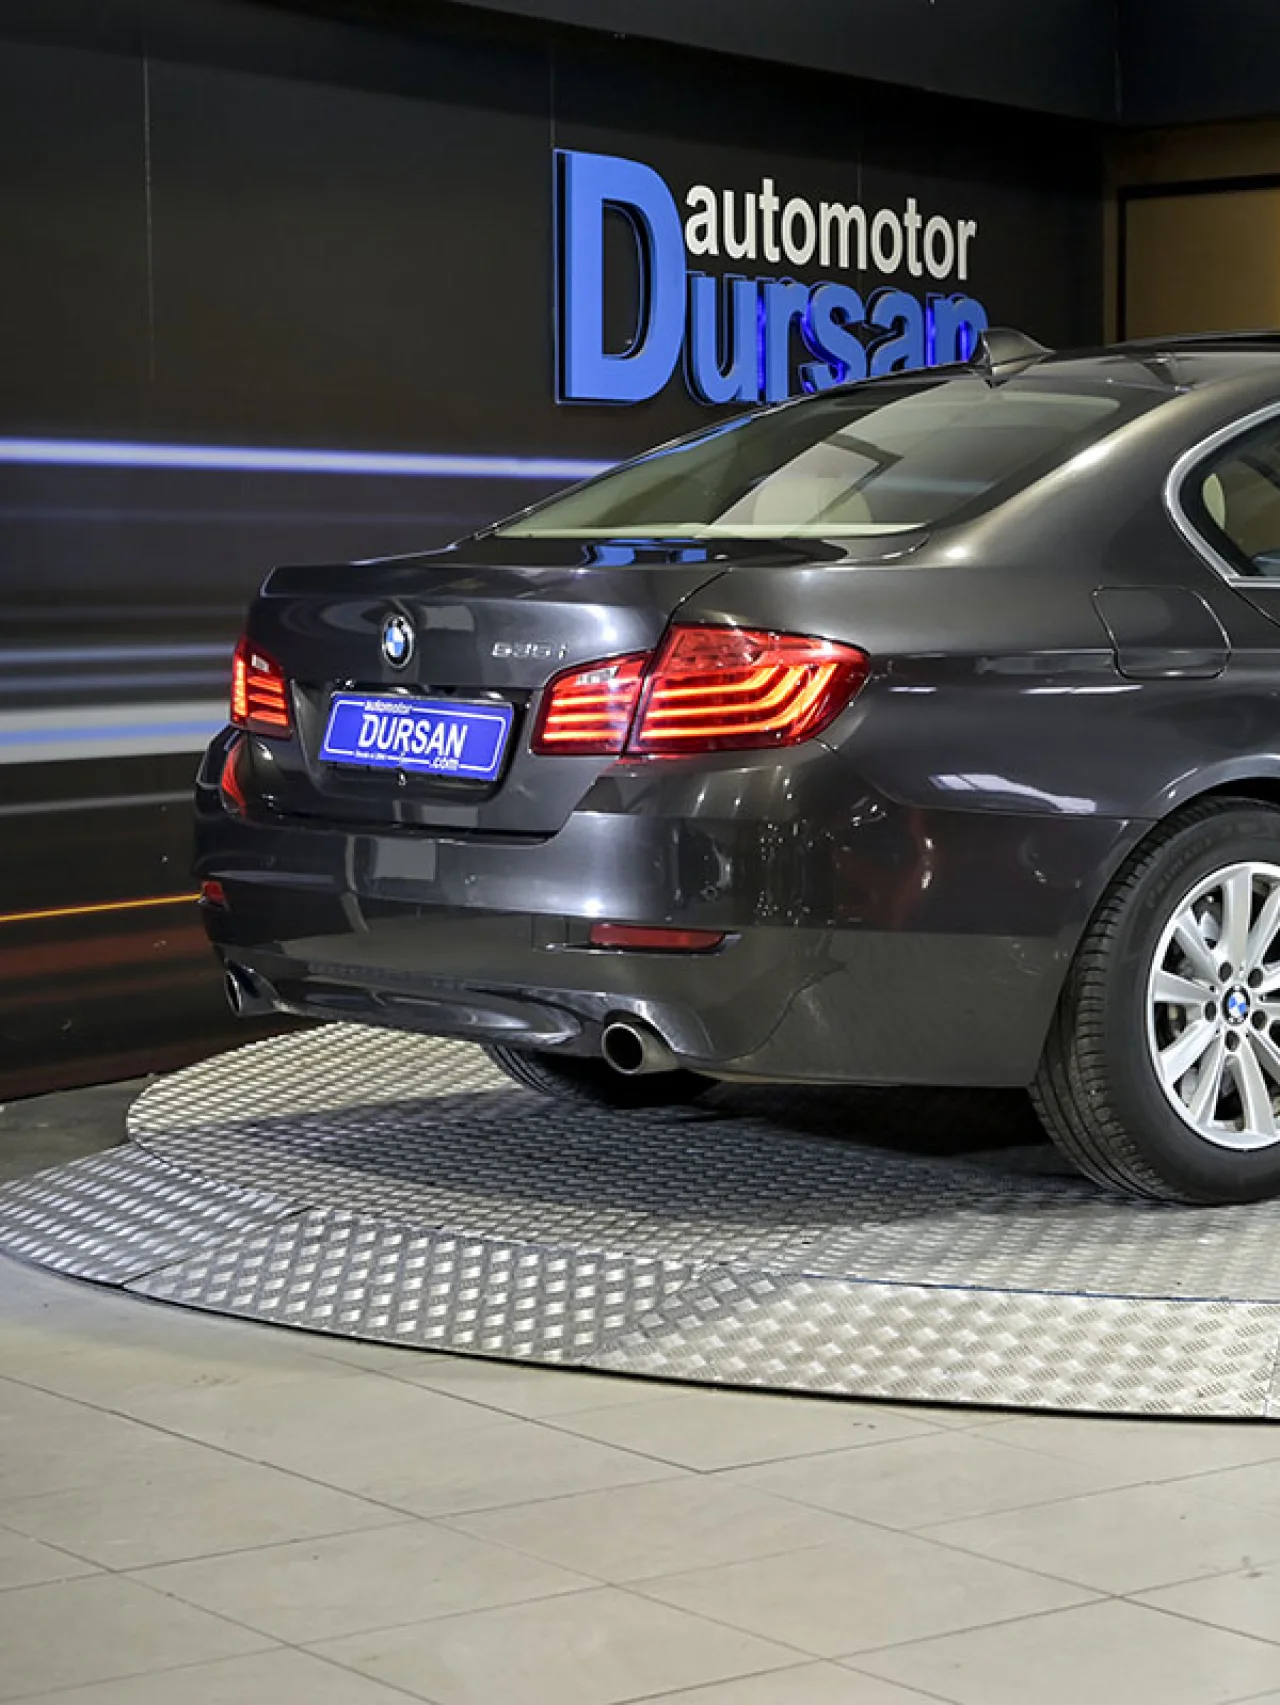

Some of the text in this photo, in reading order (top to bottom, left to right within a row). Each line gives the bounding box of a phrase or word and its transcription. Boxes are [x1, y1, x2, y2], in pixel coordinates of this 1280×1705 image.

[553, 148, 989, 406] Dursan
[685, 177, 977, 280] automotor
[357, 714, 468, 758] DURSAN
